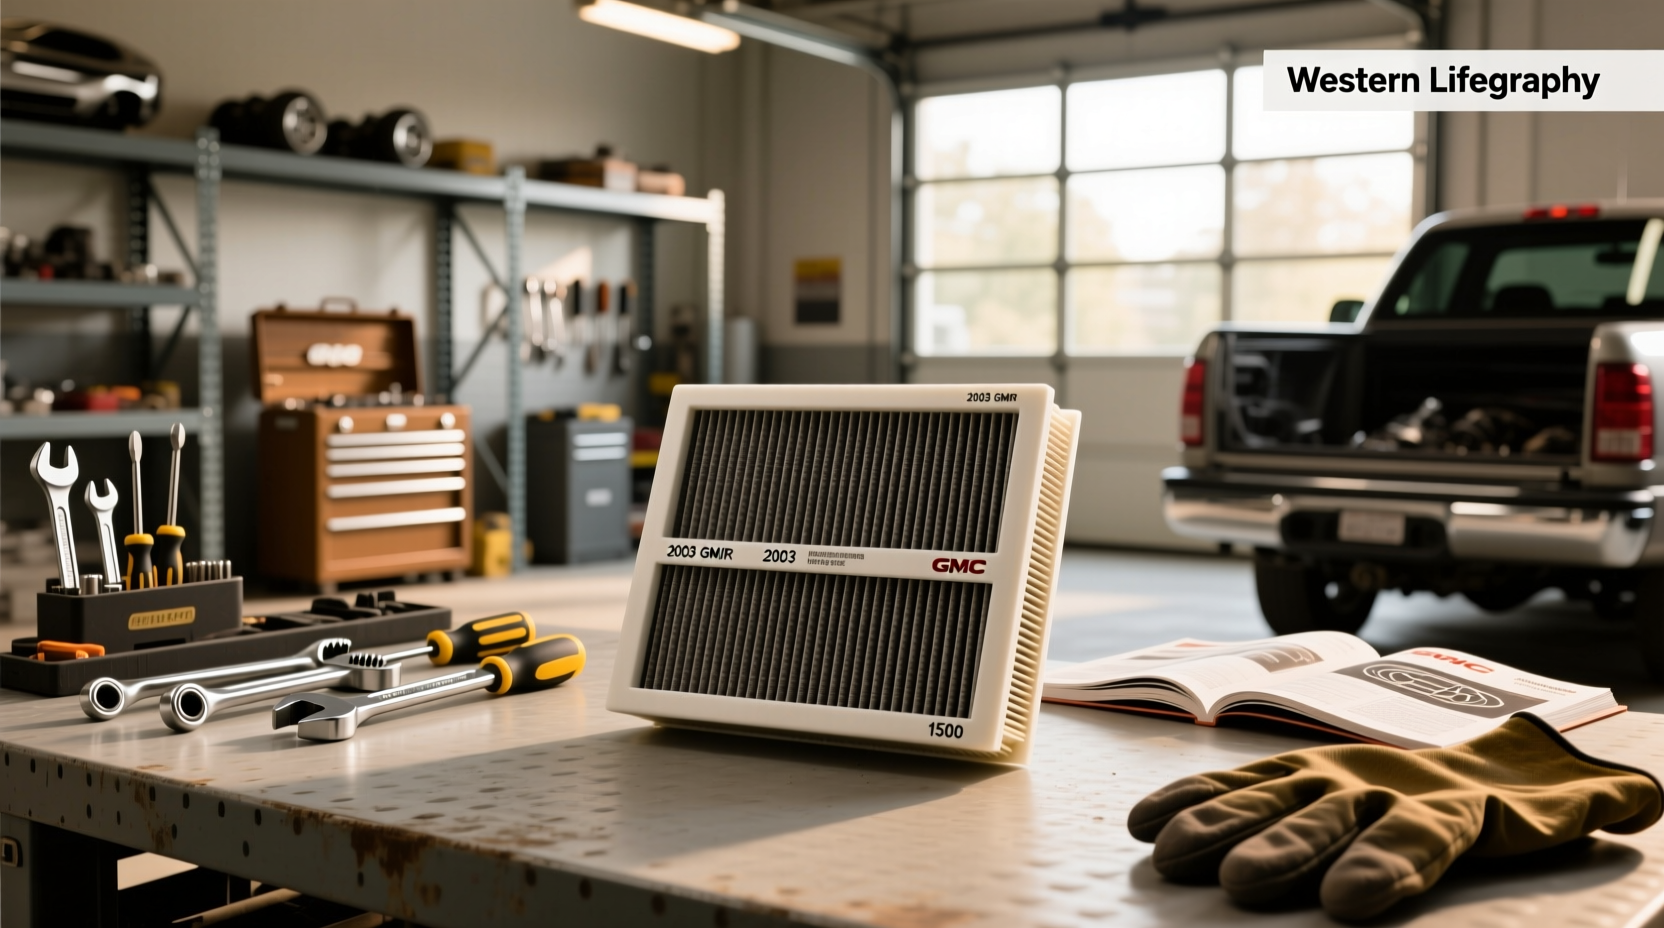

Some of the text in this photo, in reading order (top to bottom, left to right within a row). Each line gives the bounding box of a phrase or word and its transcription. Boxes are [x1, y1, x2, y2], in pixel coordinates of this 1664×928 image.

[966, 392, 1018, 402] 2003 GMR
[667, 544, 697, 558] 2003
[762, 549, 797, 564] 2003
[932, 557, 987, 574] GMC
[929, 721, 964, 739] 1500
